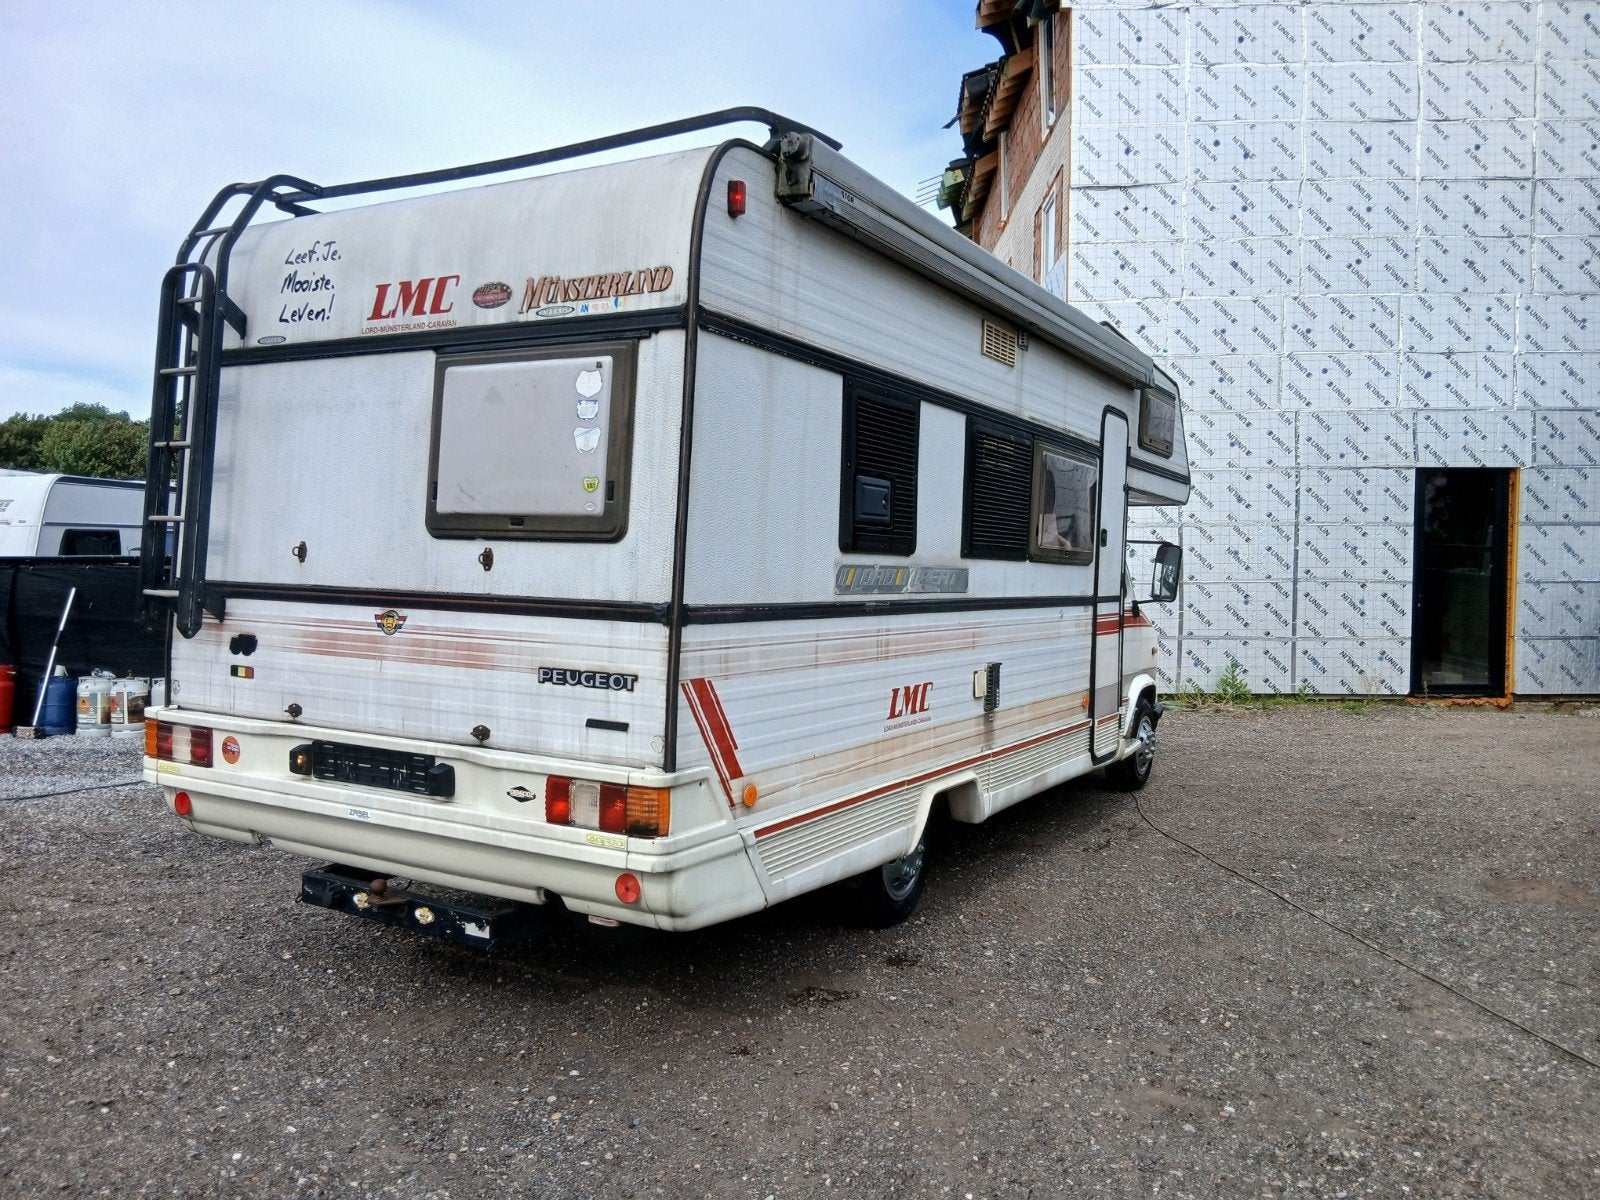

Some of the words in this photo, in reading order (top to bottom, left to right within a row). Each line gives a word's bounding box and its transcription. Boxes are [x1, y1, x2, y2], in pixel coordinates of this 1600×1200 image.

[1084, 18, 1103, 38] UNILIN
[1117, 12, 1135, 31] UNILIN
[1161, 17, 1180, 36] UNILIN
[1233, 18, 1251, 38] UNILIN
[1316, 15, 1335, 34] UNILIN
[1349, 9, 1368, 28] UNILIN
[1394, 14, 1413, 33] UNILIN
[1466, 18, 1485, 38] UNILIN
[1200, 25, 1219, 45] UNILIN
[1277, 24, 1296, 44] UNILIN
[1433, 25, 1451, 44] UNILIN
[1512, 23, 1530, 43] UNILIN
[1551, 25, 1569, 45] UNILIN
[1116, 41, 1135, 61] UNILIN
[1348, 38, 1368, 58] UNILIN
[1309, 71, 1329, 91] UNILIN
[1387, 70, 1406, 90] UNILIN
[1426, 69, 1444, 89] UNILIN
[1503, 68, 1522, 88] UNILIN
[1543, 62, 1561, 82] UNILIN
[1232, 84, 1252, 103] UNILIN
[1354, 76, 1373, 96] UNILIN
[1471, 75, 1489, 94] UNILIN
[1084, 99, 1102, 118] UNILIN
[1116, 92, 1135, 112] UNILIN
[1161, 97, 1180, 116] UNILIN
[1200, 91, 1219, 110] UNILIN
[1278, 89, 1296, 108] UNILIN
[1542, 91, 1560, 111] UNILIN
[1541, 120, 1560, 139] UNILIN
[1083, 139, 1102, 159] UNILIN
[1160, 137, 1179, 157] UNILIN
[1199, 143, 1218, 162] UNILIN
[1277, 141, 1295, 160] UNILIN
[1316, 135, 1334, 154] UNILIN
[1393, 134, 1412, 153] UNILIN
[1425, 146, 1444, 166] UNILIN
[1469, 152, 1488, 171] UNILIN
[1502, 146, 1520, 165] UNILIN
[1541, 149, 1559, 169] UNILIN
[1190, 187, 1210, 207] UNILIN
[1267, 185, 1288, 205] UNILIN
[1353, 181, 1372, 201] UNILIN
[1422, 195, 1443, 216] UNILIN
[1500, 195, 1520, 215] UNILIN
[1074, 212, 1094, 233] UNILIN
[1119, 215, 1139, 235] UNILIN
[1151, 210, 1171, 231] UNILIN
[1189, 216, 1210, 236] UNILIN
[1268, 214, 1288, 234] UNILIN
[1306, 206, 1327, 228] UNILIN
[1352, 210, 1372, 231] UNILIN
[1383, 206, 1404, 227] UNILIN
[1538, 207, 1558, 228] UNILIN
[1351, 239, 1372, 258] UNILIN
[1073, 251, 1093, 272] UNILIN
[1150, 249, 1170, 270] UNILIN
[1422, 259, 1443, 279] UNILIN
[1499, 258, 1519, 280] UNILIN
[1189, 262, 1209, 282] UNILIN
[1266, 260, 1287, 280] UNILIN
[1306, 264, 1326, 285] UNILIN
[1351, 267, 1371, 288] UNILIN
[1383, 262, 1403, 284] UNILIN
[1538, 265, 1558, 286] UNILIN
[281, 270, 334, 294] Mooiste.
[518, 265, 674, 314] MÜNSTERLAND
[366, 275, 460, 320] LMC
[1141, 304, 1161, 323] UNILIN
[1180, 304, 1200, 324] UNILIN
[1212, 299, 1232, 320] UNILIN
[1258, 302, 1277, 322] UNILIN
[1297, 299, 1317, 319] UNILIN
[1375, 298, 1395, 318] UNILIN
[1446, 317, 1466, 337] UNILIN
[1530, 309, 1550, 330] UNILIN
[1297, 329, 1317, 348] UNILIN
[1328, 324, 1349, 344] UNILIN
[1375, 327, 1395, 347] UNILIN
[1414, 320, 1434, 341] UNILIN
[1491, 320, 1511, 341] UNILIN
[1180, 333, 1200, 353] UNILIN
[1257, 331, 1277, 351] UNILIN
[1170, 361, 1190, 382] UNILIN
[1247, 359, 1267, 380] UNILIN
[1333, 357, 1352, 377] UNILIN
[1450, 358, 1470, 378] UNILIN
[1482, 354, 1502, 375] UNILIN
[1520, 361, 1541, 382] UNILIN
[1286, 382, 1306, 403] UNILIN
[1332, 386, 1352, 405] UNILIN
[1364, 381, 1385, 401] UNILIN
[1404, 383, 1424, 404] UNILIN
[1450, 387, 1470, 407] UNILIN
[1481, 384, 1502, 404] UNILIN
[1430, 419, 1449, 440] UNILIN
[1462, 415, 1482, 436] UNILIN
[1508, 419, 1527, 440] UNILIN
[1577, 416, 1597, 437] UNILIN
[1195, 436, 1214, 456] UNILIN
[1272, 435, 1292, 454] UNILIN
[1311, 441, 1331, 460] UNILIN
[1343, 436, 1363, 457] UNILIN
[1389, 439, 1410, 460] UNILIN
[1194, 489, 1214, 509] UNILIN
[1272, 488, 1291, 508] UNILIN
[1311, 491, 1331, 512] UNILIN
[1343, 488, 1363, 508] UNILIN
[1389, 491, 1409, 511] UNILIN
[1524, 485, 1544, 506] UNILIN
[1569, 489, 1587, 509] UNILIN
[1194, 551, 1213, 571] UNILIN
[1271, 550, 1291, 570] UNILIN
[1310, 545, 1330, 565] UNILIN
[1388, 545, 1407, 565] UNILIN
[1530, 547, 1548, 566] UNILIN
[1309, 596, 1328, 616] UNILIN
[1340, 592, 1361, 613] UNILIN
[1387, 596, 1406, 616] UNILIN
[1521, 599, 1540, 618] UNILIN
[1193, 607, 1212, 627] UNILIN
[1224, 603, 1244, 624] UNILIN
[1270, 607, 1289, 627] UNILIN
[1565, 604, 1583, 623] UNILIN
[1268, 654, 1288, 674] UNILIN
[1339, 650, 1359, 671] UNILIN
[1385, 654, 1405, 674] UNILIN
[538, 667, 638, 692] PEUGEOT
[1527, 670, 1545, 688] UNILIN
[1559, 664, 1577, 683] UNILIN
[886, 682, 933, 720] LMC
